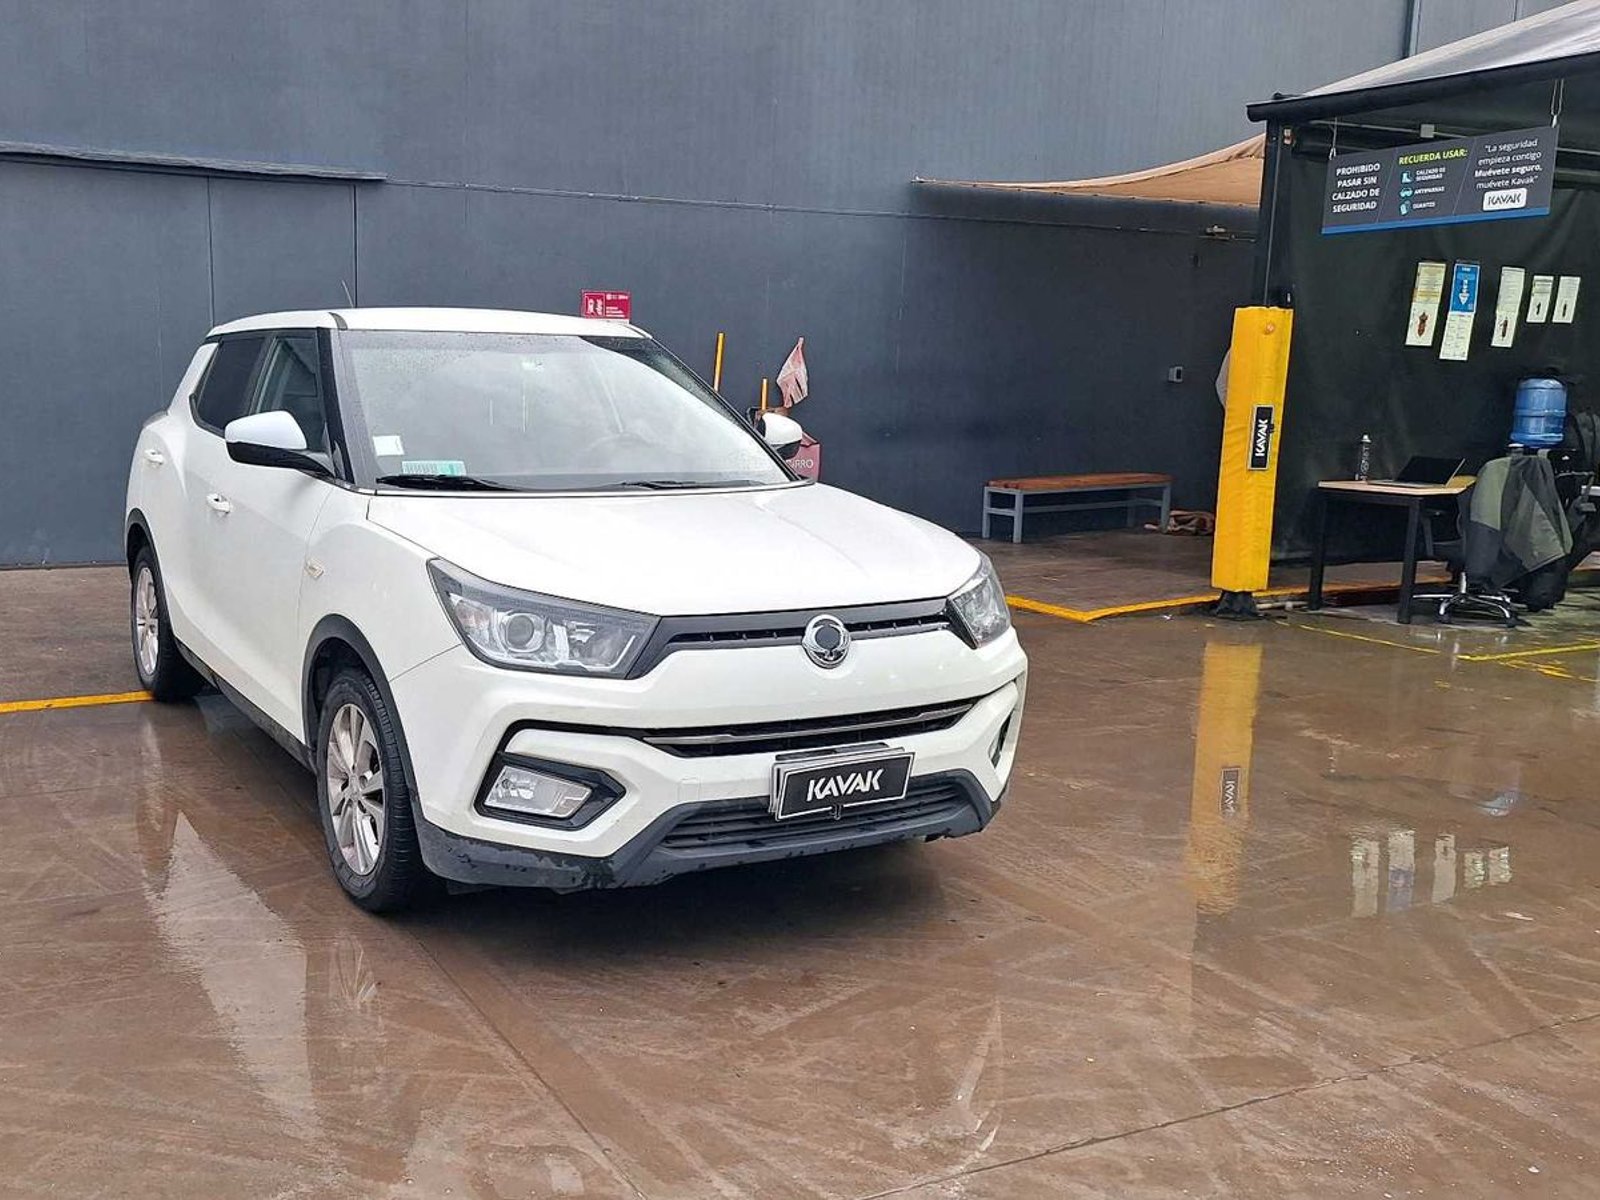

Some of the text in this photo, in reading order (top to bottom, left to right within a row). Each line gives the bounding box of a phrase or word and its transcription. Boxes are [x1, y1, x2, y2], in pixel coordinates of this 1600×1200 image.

[1499, 138, 1538, 152] seguridad
[1399, 148, 1468, 165] RECUERDA USAR:
[1478, 151, 1542, 166] empieza contigo
[1336, 163, 1380, 176] PROHIBIDO
[1474, 164, 1543, 177] Muévete seguro,
[1337, 176, 1378, 188] PASAR SIN
[1332, 187, 1381, 201] CALZADO DE
[1487, 193, 1522, 206] KAVAK
[1332, 201, 1378, 213] SEGURIDAD
[1254, 418, 1269, 457] KAVAK
[806, 768, 885, 802] KAVAK
